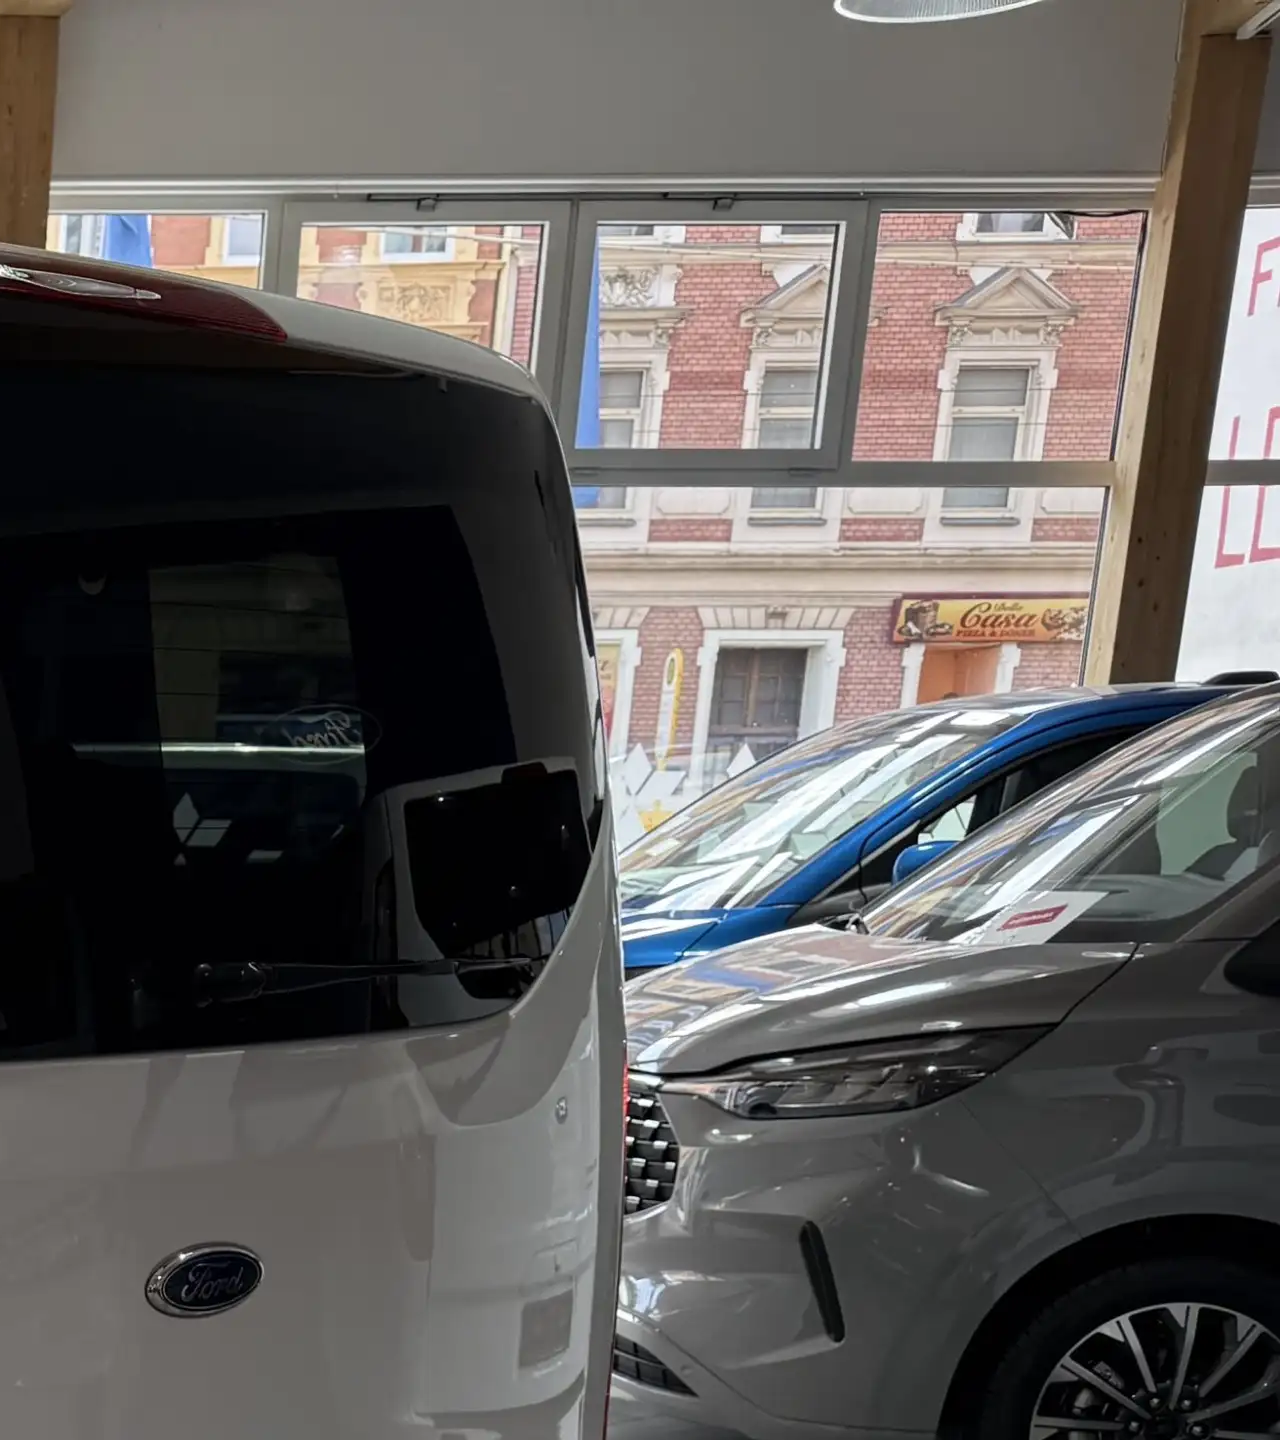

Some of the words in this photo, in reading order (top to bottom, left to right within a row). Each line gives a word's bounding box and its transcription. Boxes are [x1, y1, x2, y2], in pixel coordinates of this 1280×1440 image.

[1248, 236, 1280, 318] F
[960, 601, 1039, 629] Casa
[181, 1260, 244, 1302] Ford
